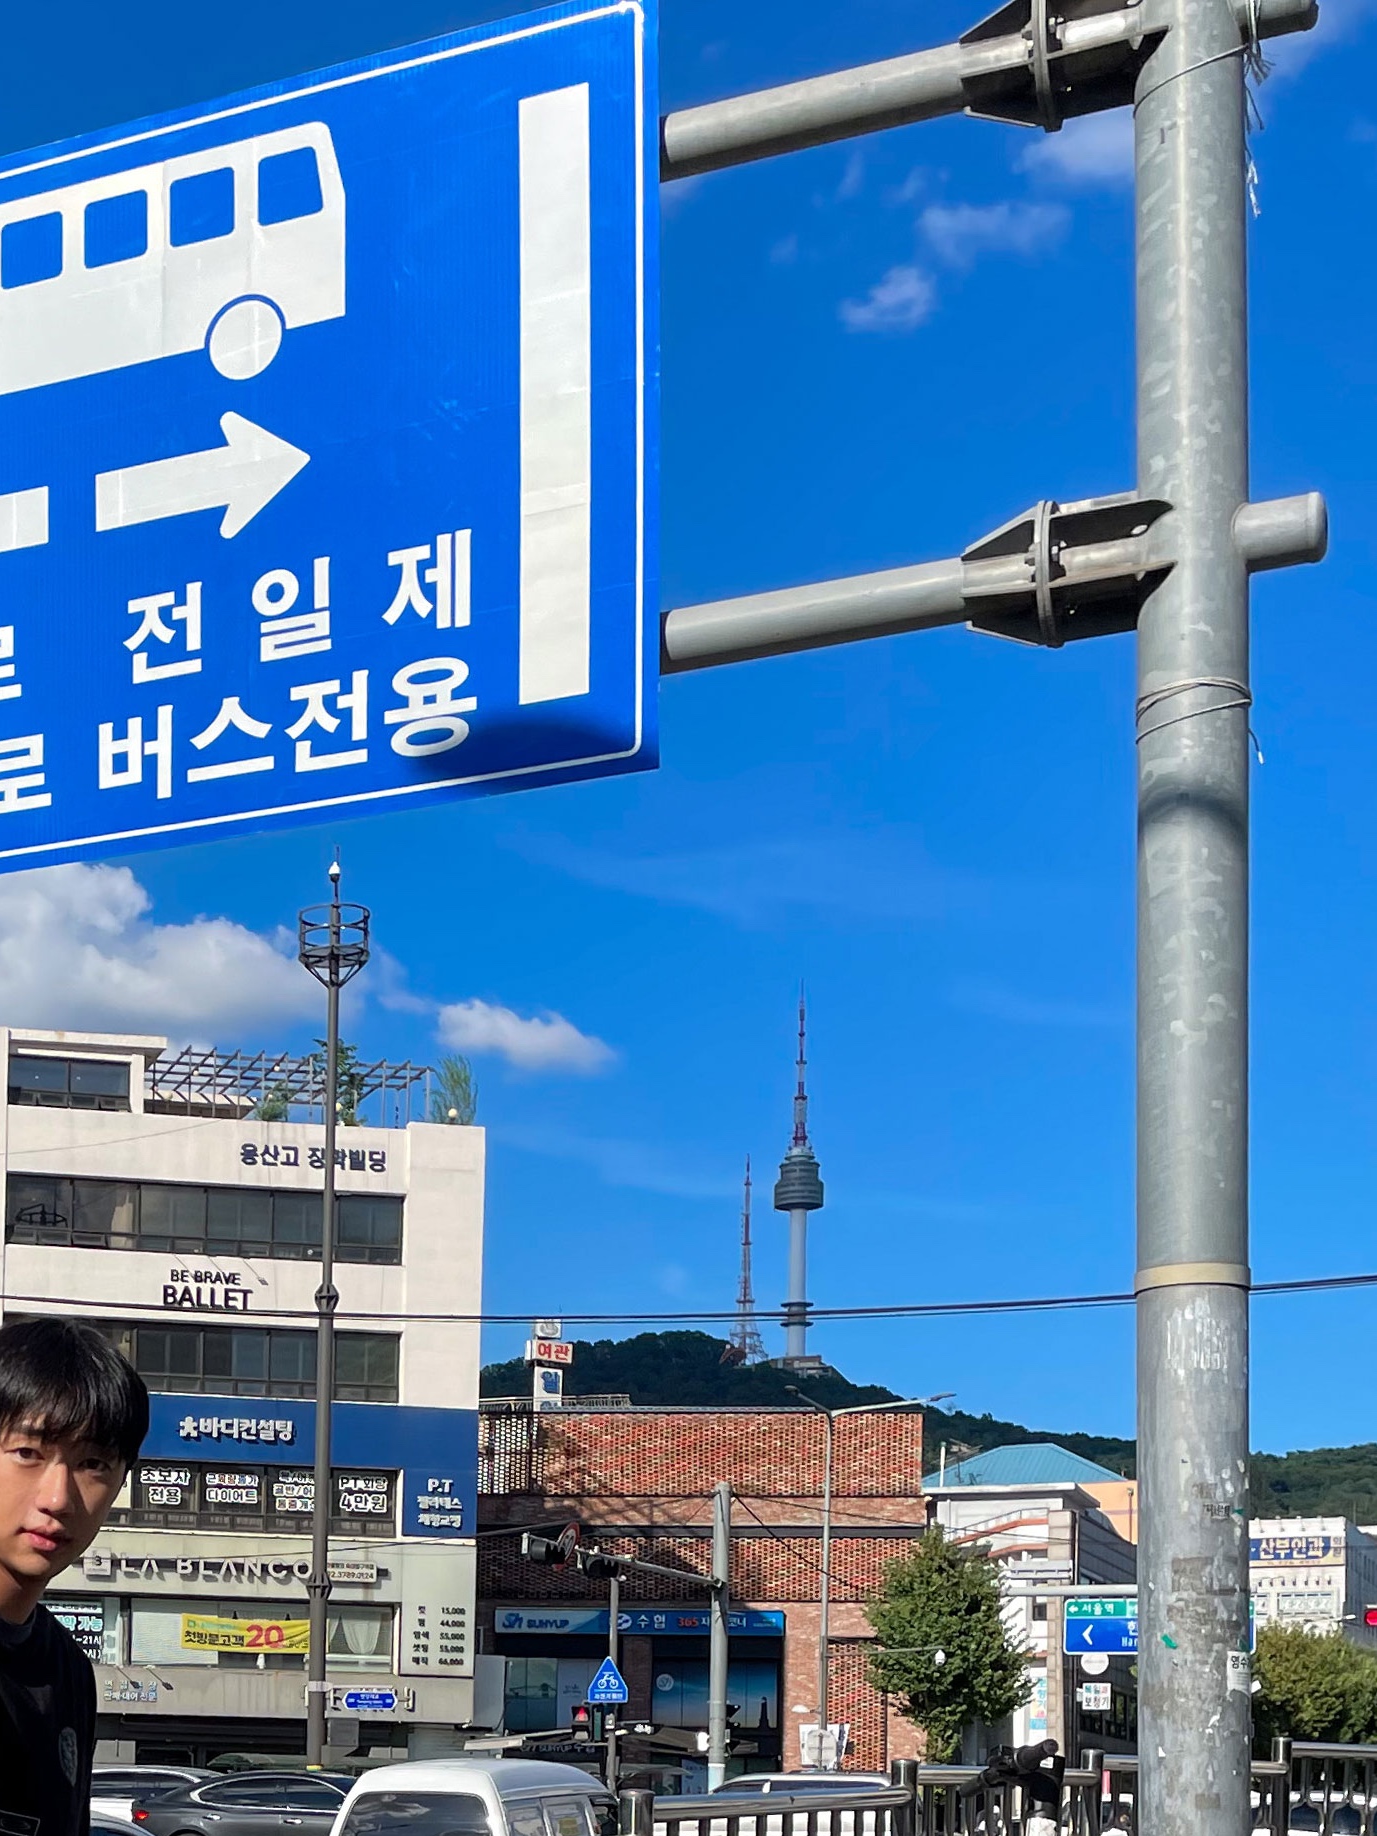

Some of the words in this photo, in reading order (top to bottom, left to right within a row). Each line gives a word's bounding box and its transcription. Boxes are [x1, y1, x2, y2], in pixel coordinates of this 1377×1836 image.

[97, 656, 478, 800] 버스전용
[240, 1143, 300, 1167] 용산고
[170, 1269, 190, 1283] BE
[194, 1270, 241, 1286] BRAVE
[162, 1285, 254, 1310] BALLET
[537, 1343, 570, 1361] 여관
[199, 1416, 293, 1442] 바디컨설팅
[140, 1466, 190, 1485] 초보자
[339, 1475, 360, 1491] PT
[428, 1478, 453, 1493] P.T
[149, 1487, 182, 1504] 전용
[206, 1488, 258, 1503] 다이어트
[339, 1493, 388, 1513] 4만원
[1259, 1537, 1325, 1559] 산부인과
[120, 1553, 160, 1573] LA
[175, 1557, 313, 1579] BLANCO
[442, 1607, 465, 1615] 15,000
[1081, 1603, 1115, 1615] 서울역
[78, 1616, 102, 1631] 가능
[678, 1617, 698, 1627] 365
[184, 1630, 244, 1648] 첫방문고객
[1084, 1695, 1110, 1709] 보청기
